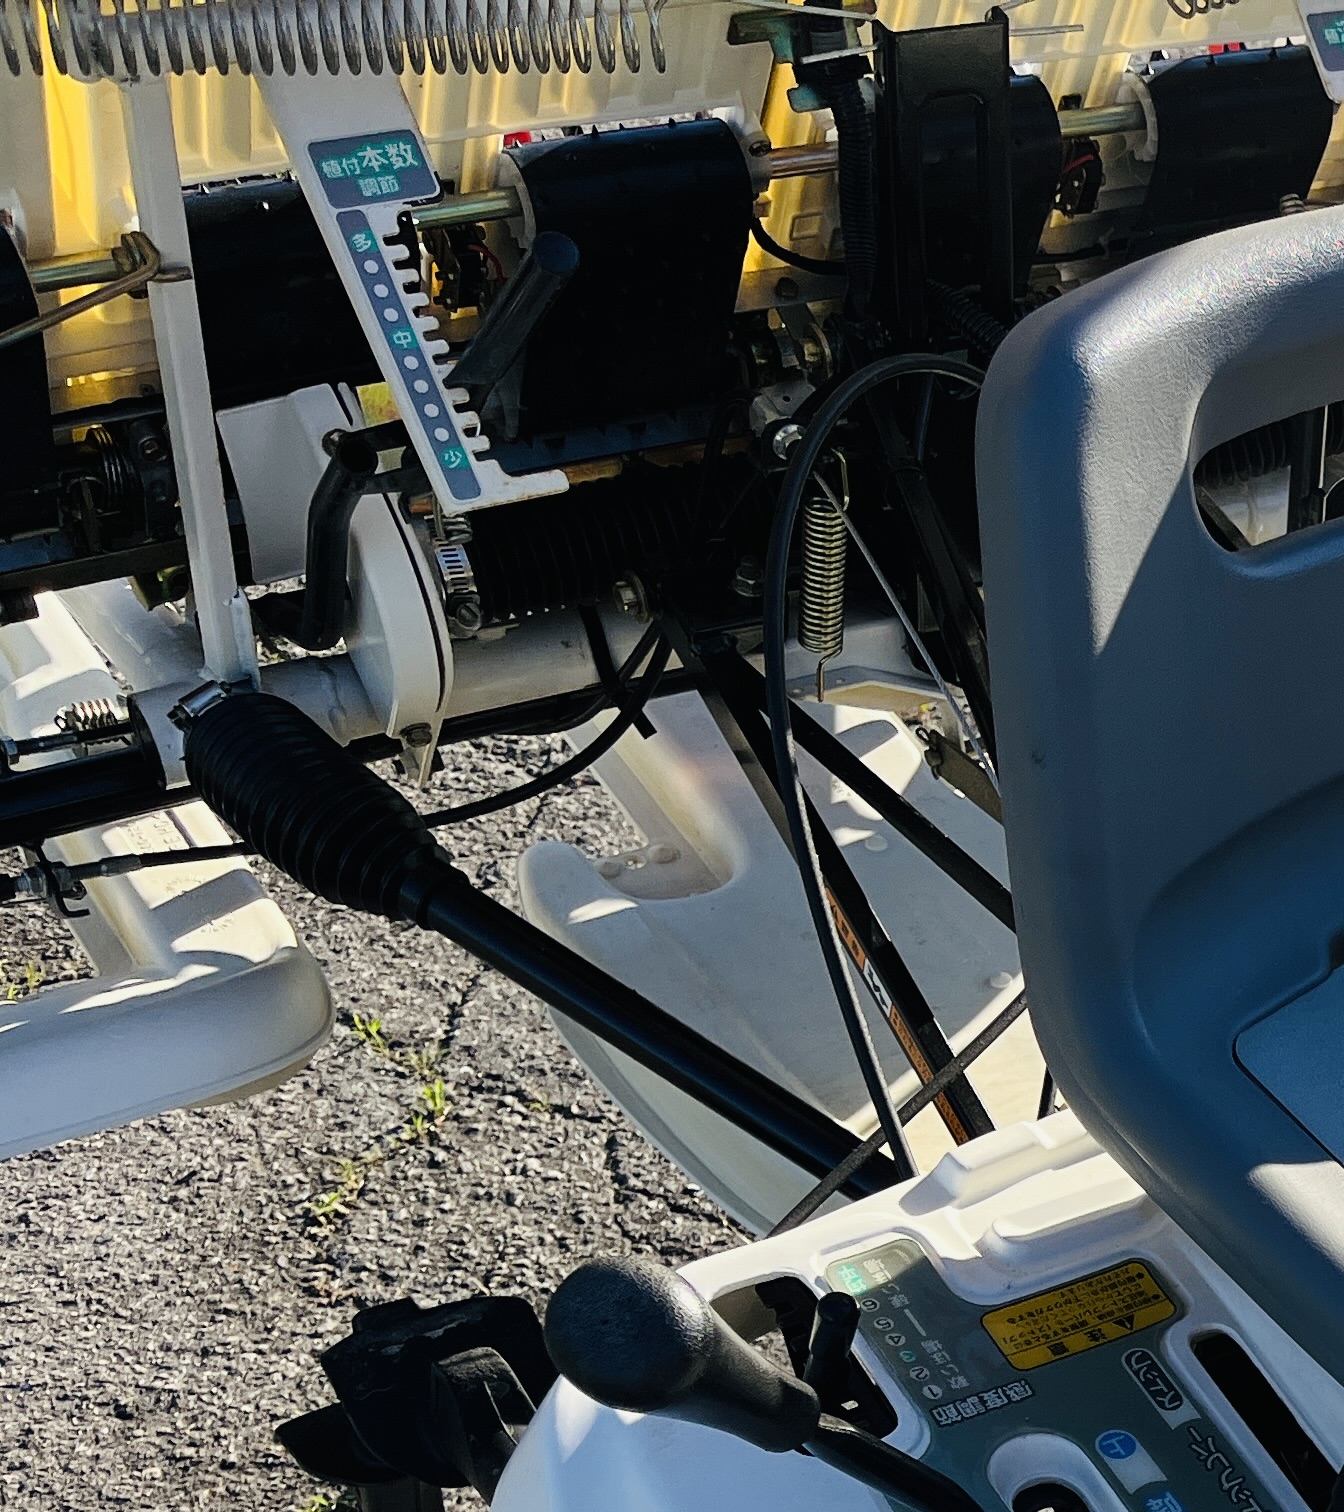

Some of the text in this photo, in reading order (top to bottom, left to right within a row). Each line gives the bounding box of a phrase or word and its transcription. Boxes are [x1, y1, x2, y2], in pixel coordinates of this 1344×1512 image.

[320, 141, 419, 181] 植付本数
[357, 174, 401, 197] 調節
[352, 232, 372, 255] 多
[392, 328, 413, 350] 中
[1129, 1350, 1180, 1410] ストップ
[930, 1380, 1032, 1425] 感度調節
[1098, 1435, 1126, 1456] 上
